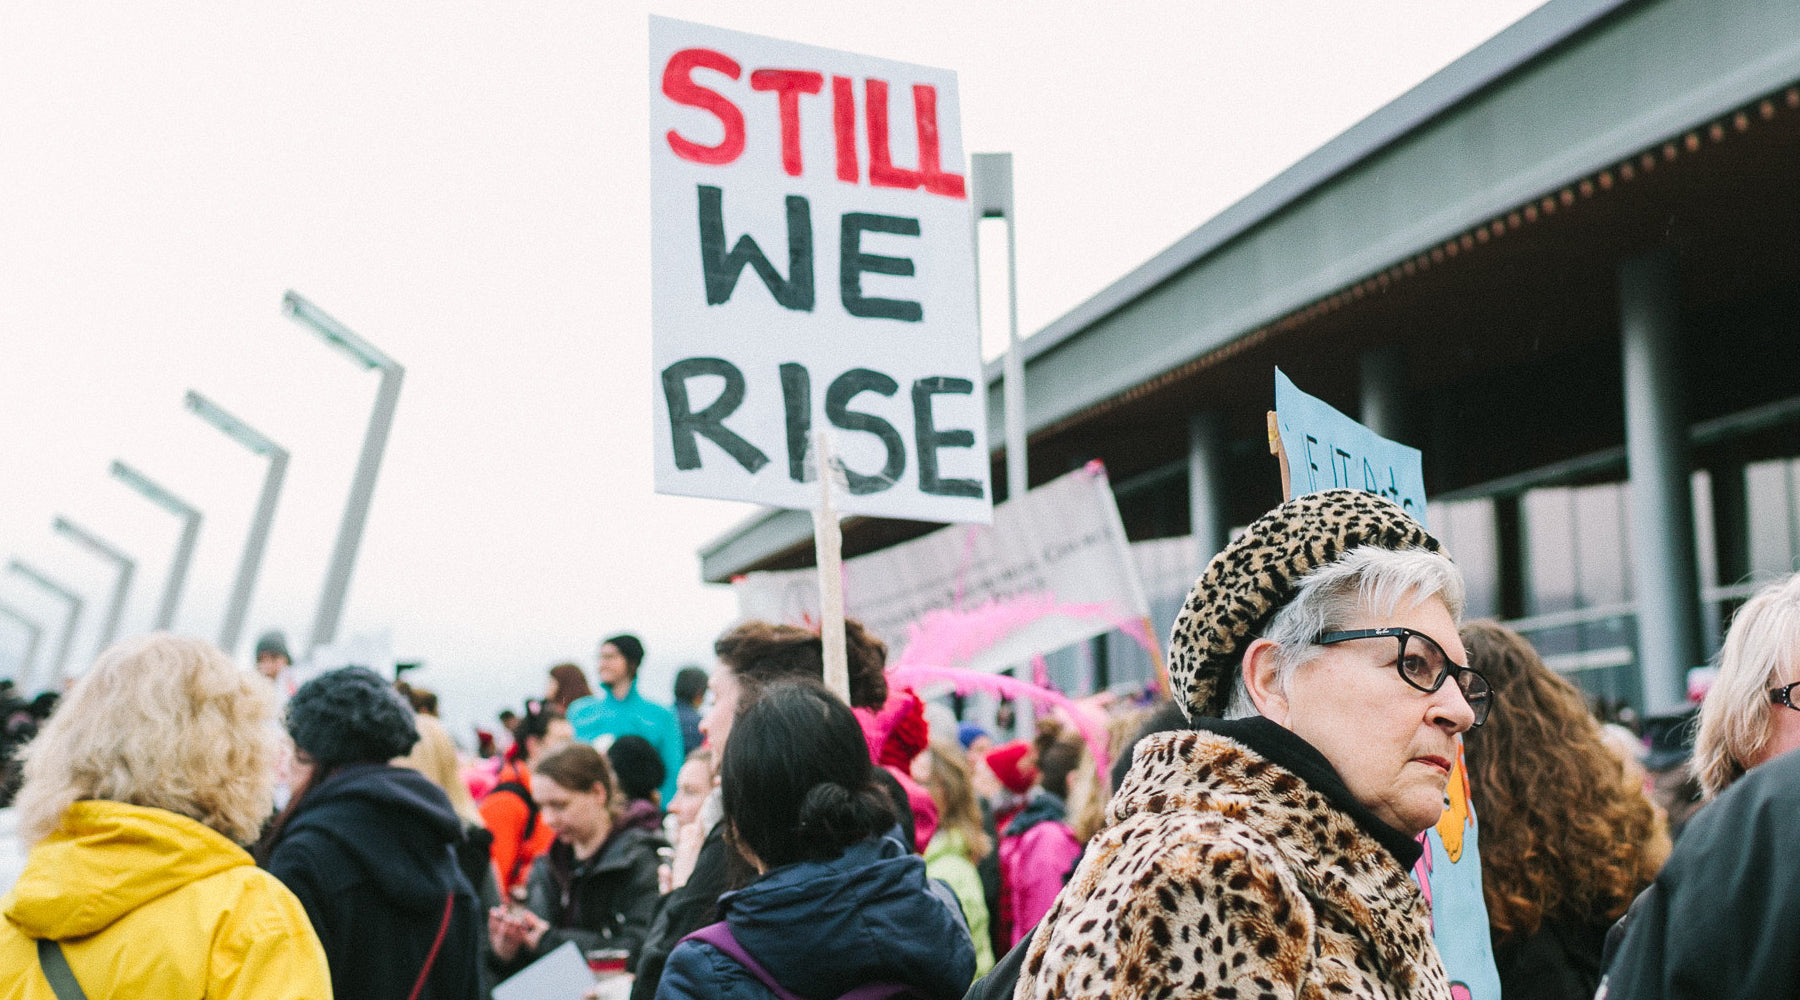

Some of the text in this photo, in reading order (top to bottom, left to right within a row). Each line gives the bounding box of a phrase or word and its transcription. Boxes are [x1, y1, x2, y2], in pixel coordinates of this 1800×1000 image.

[661, 47, 967, 199] STILL
[697, 184, 923, 322] WE
[661, 356, 983, 500] RISE
